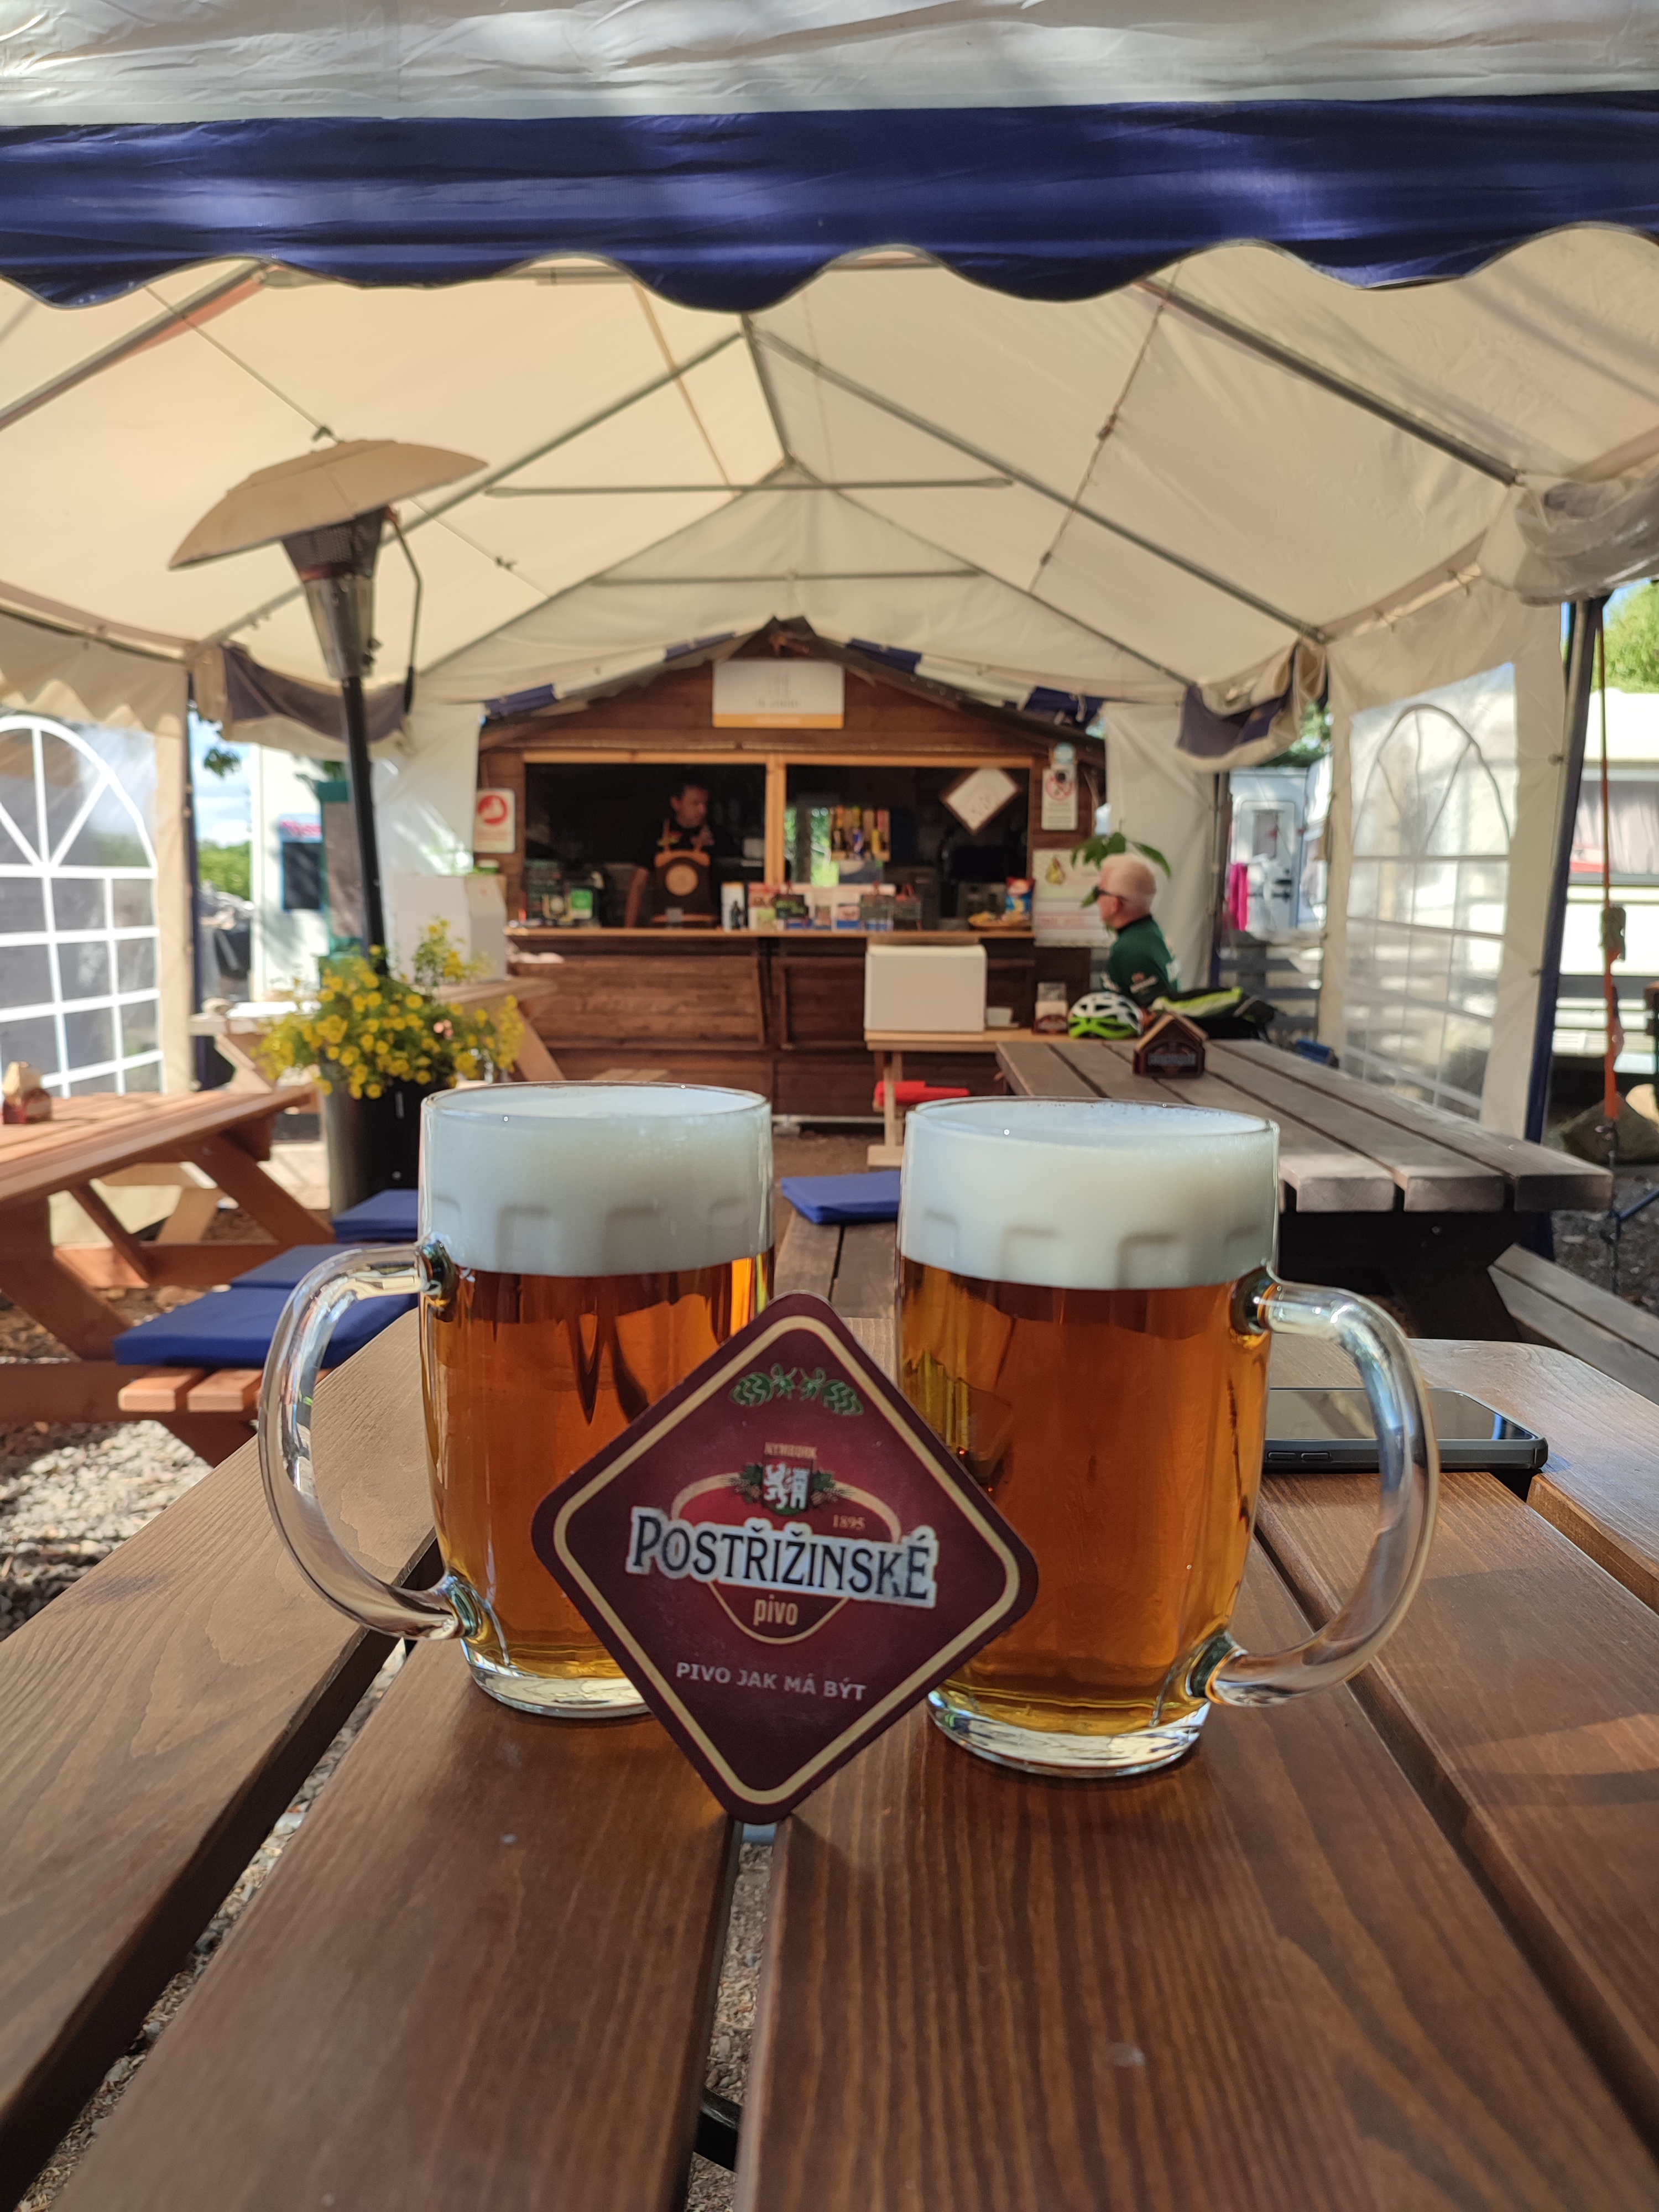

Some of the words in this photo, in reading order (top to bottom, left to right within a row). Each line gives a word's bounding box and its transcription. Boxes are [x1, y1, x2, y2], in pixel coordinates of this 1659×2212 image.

[833, 1514, 866, 1531] 1895
[632, 1515, 931, 1600] POSTŘIŽINSKÉ
[753, 1594, 799, 1626] pivo
[676, 1662, 732, 1685] PIVO
[736, 1669, 778, 1689] JAK
[783, 1672, 817, 1695] MÁ
[823, 1677, 867, 1702] BÝT
